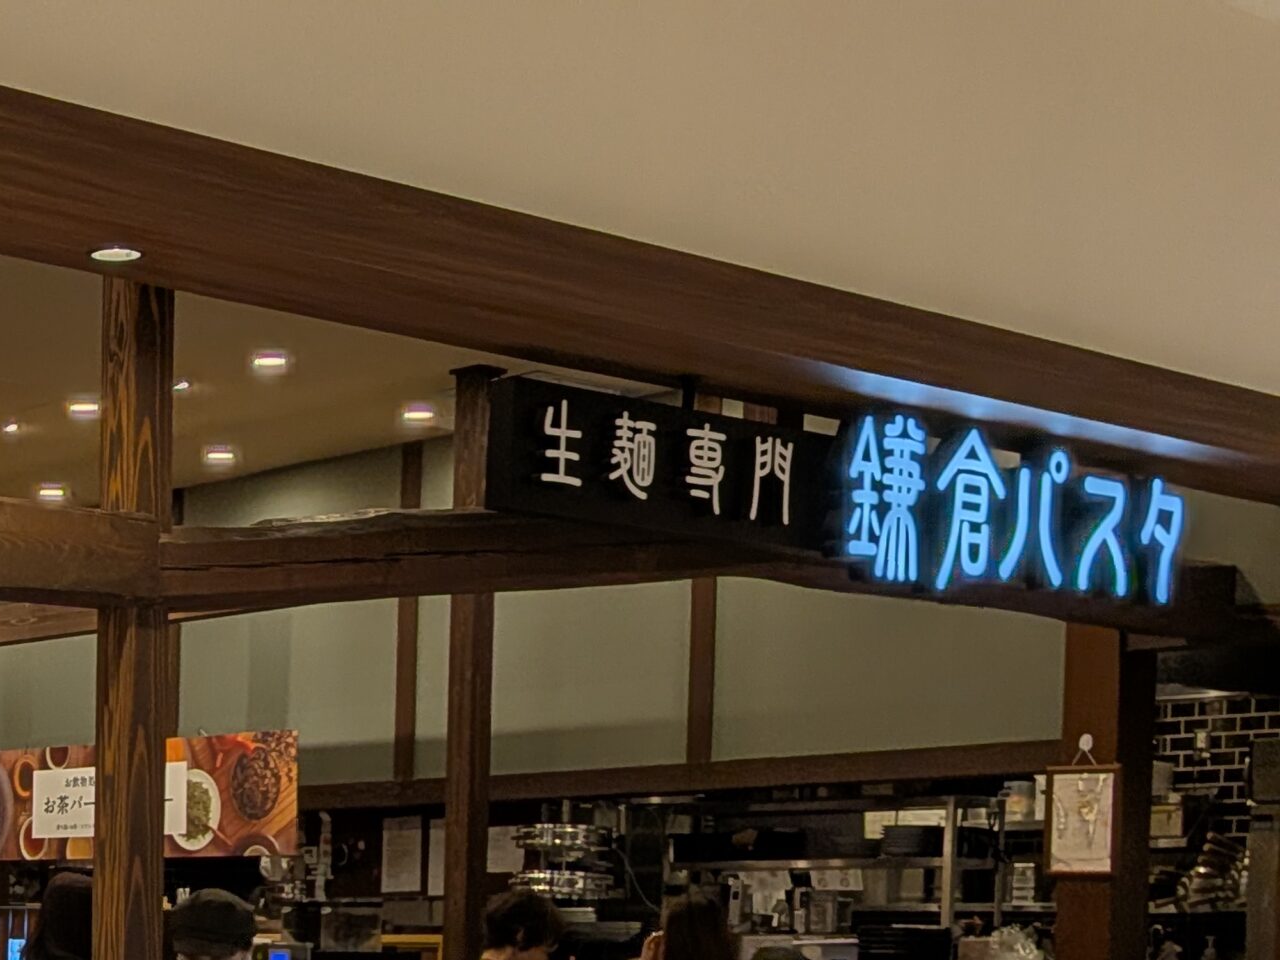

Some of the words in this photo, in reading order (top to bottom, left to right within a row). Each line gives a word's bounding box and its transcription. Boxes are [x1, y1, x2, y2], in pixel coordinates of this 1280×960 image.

[539, 398, 795, 525] 生麺専門
[847, 413, 1186, 604] 鎌倉パスタ
